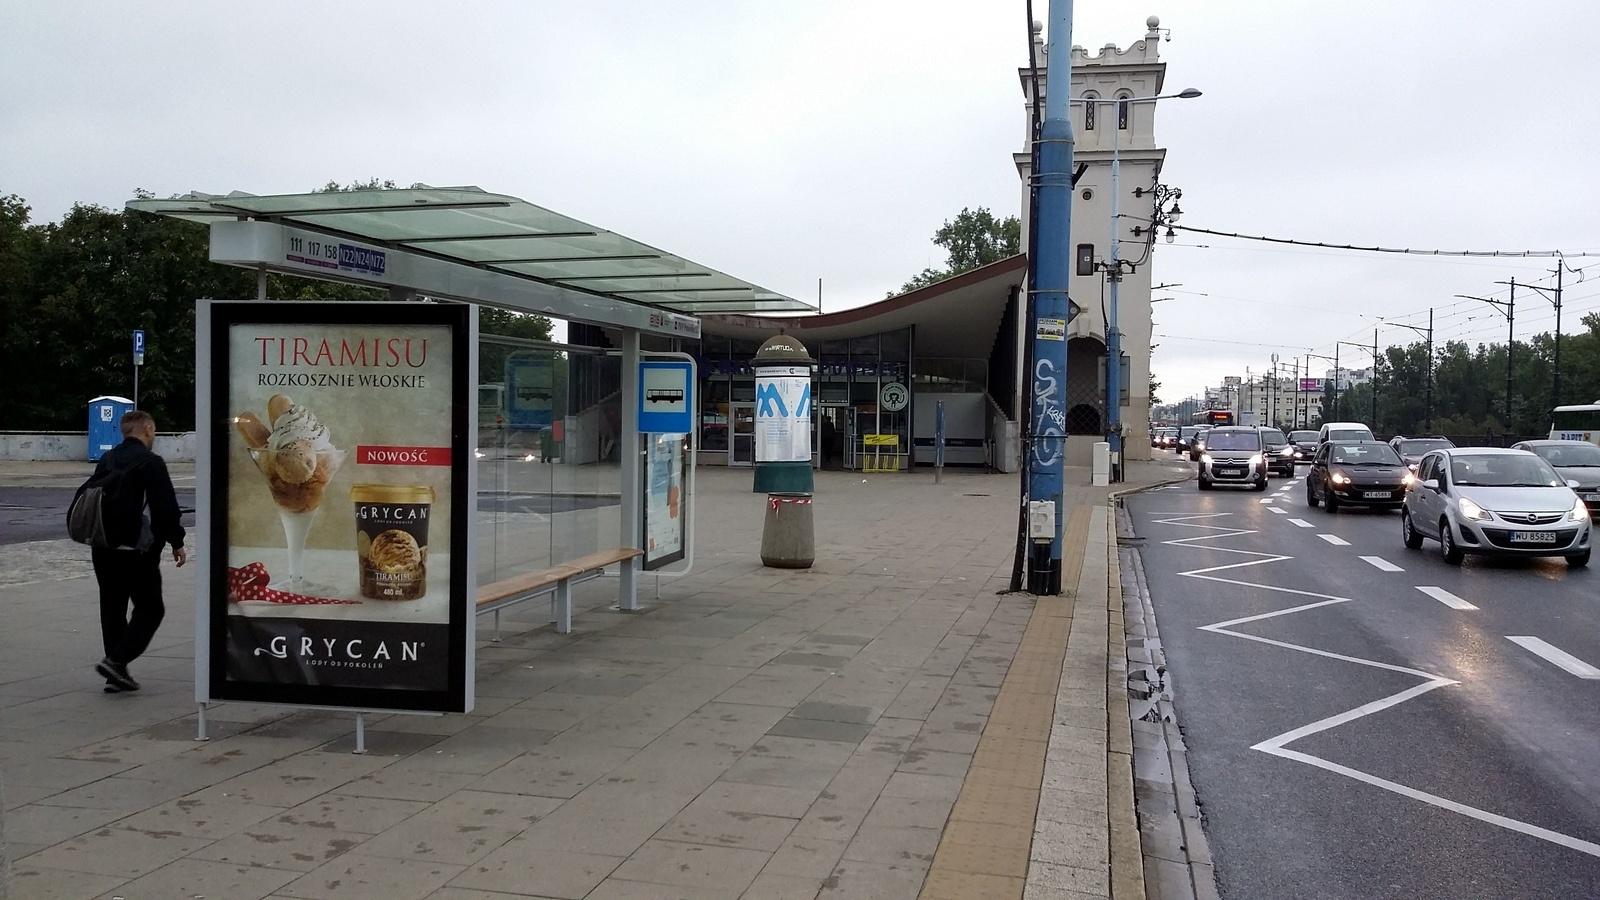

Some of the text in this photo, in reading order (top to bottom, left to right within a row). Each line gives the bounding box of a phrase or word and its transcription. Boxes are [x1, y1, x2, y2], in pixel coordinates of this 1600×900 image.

[290, 237, 303, 253] 111
[308, 241, 321, 256] 117
[324, 244, 338, 260] 158
[339, 248, 355, 264] N22
[355, 250, 370, 267] N24
[370, 253, 385, 269] N72
[136, 332, 143, 351] P
[254, 337, 429, 368] TIRAMISU
[258, 373, 426, 388] ROZKOSZNIE WŁOSKIE
[367, 448, 429, 464] NOWOŚĆ
[357, 506, 428, 520] GRYCAN
[254, 635, 418, 661] GRYCAN
